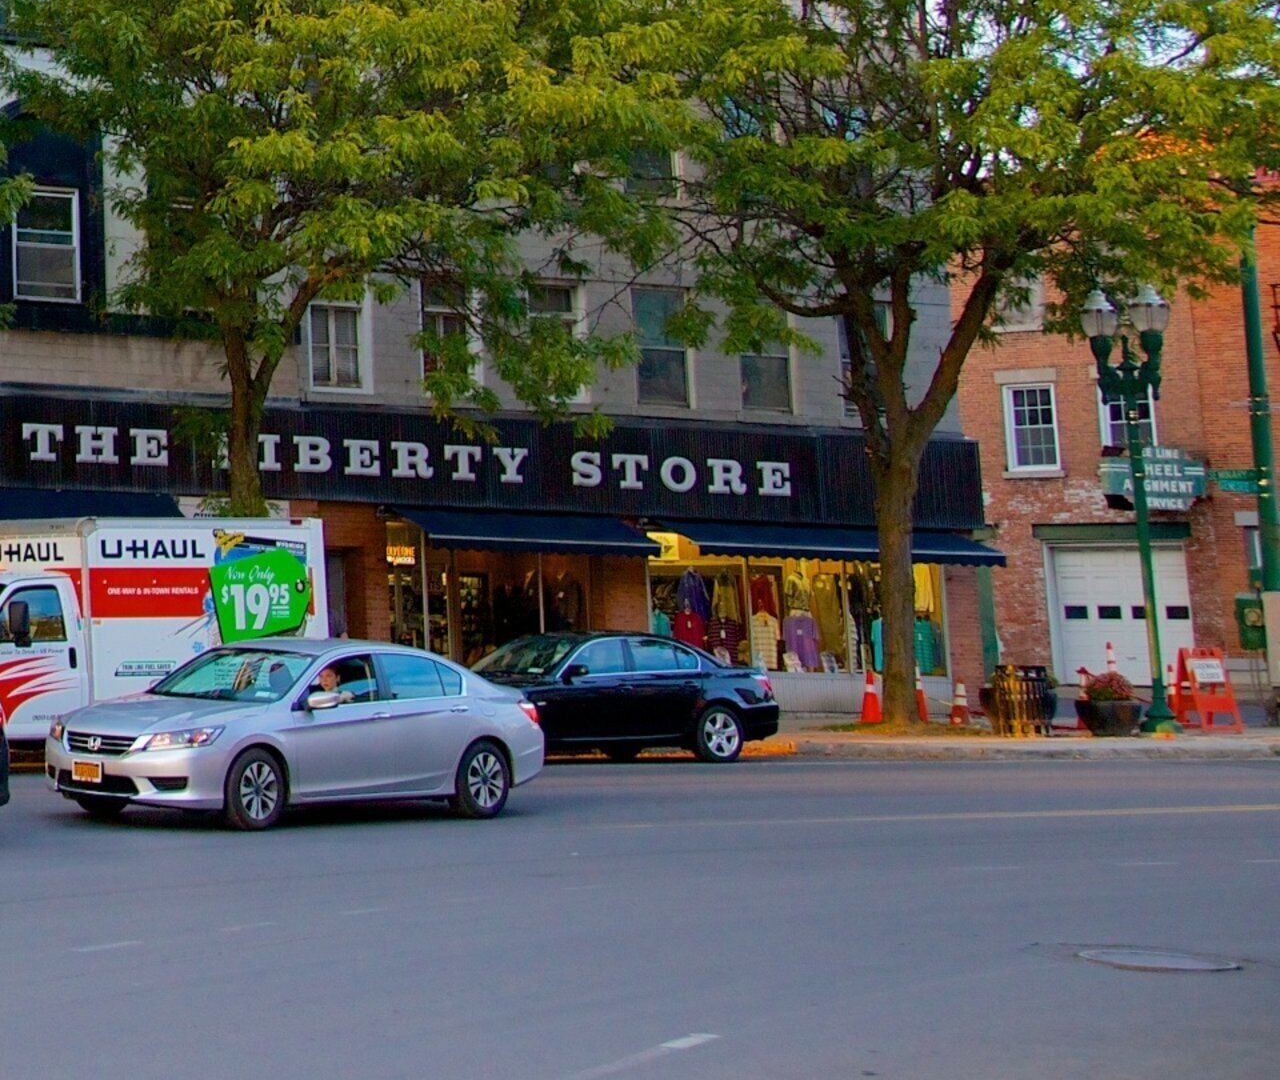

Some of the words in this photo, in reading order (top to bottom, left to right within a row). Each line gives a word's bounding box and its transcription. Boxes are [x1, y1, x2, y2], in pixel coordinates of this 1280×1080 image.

[22, 422, 169, 468] THE
[570, 450, 792, 498] STORE
[1155, 448, 1180, 459] LINE
[1144, 463, 1183, 477] HEEL
[1123, 478, 1195, 493] AGNMENT
[1146, 497, 1184, 510] ERVICE
[100, 539, 207, 560] U-HAUL
[248, 565, 276, 584] Only
